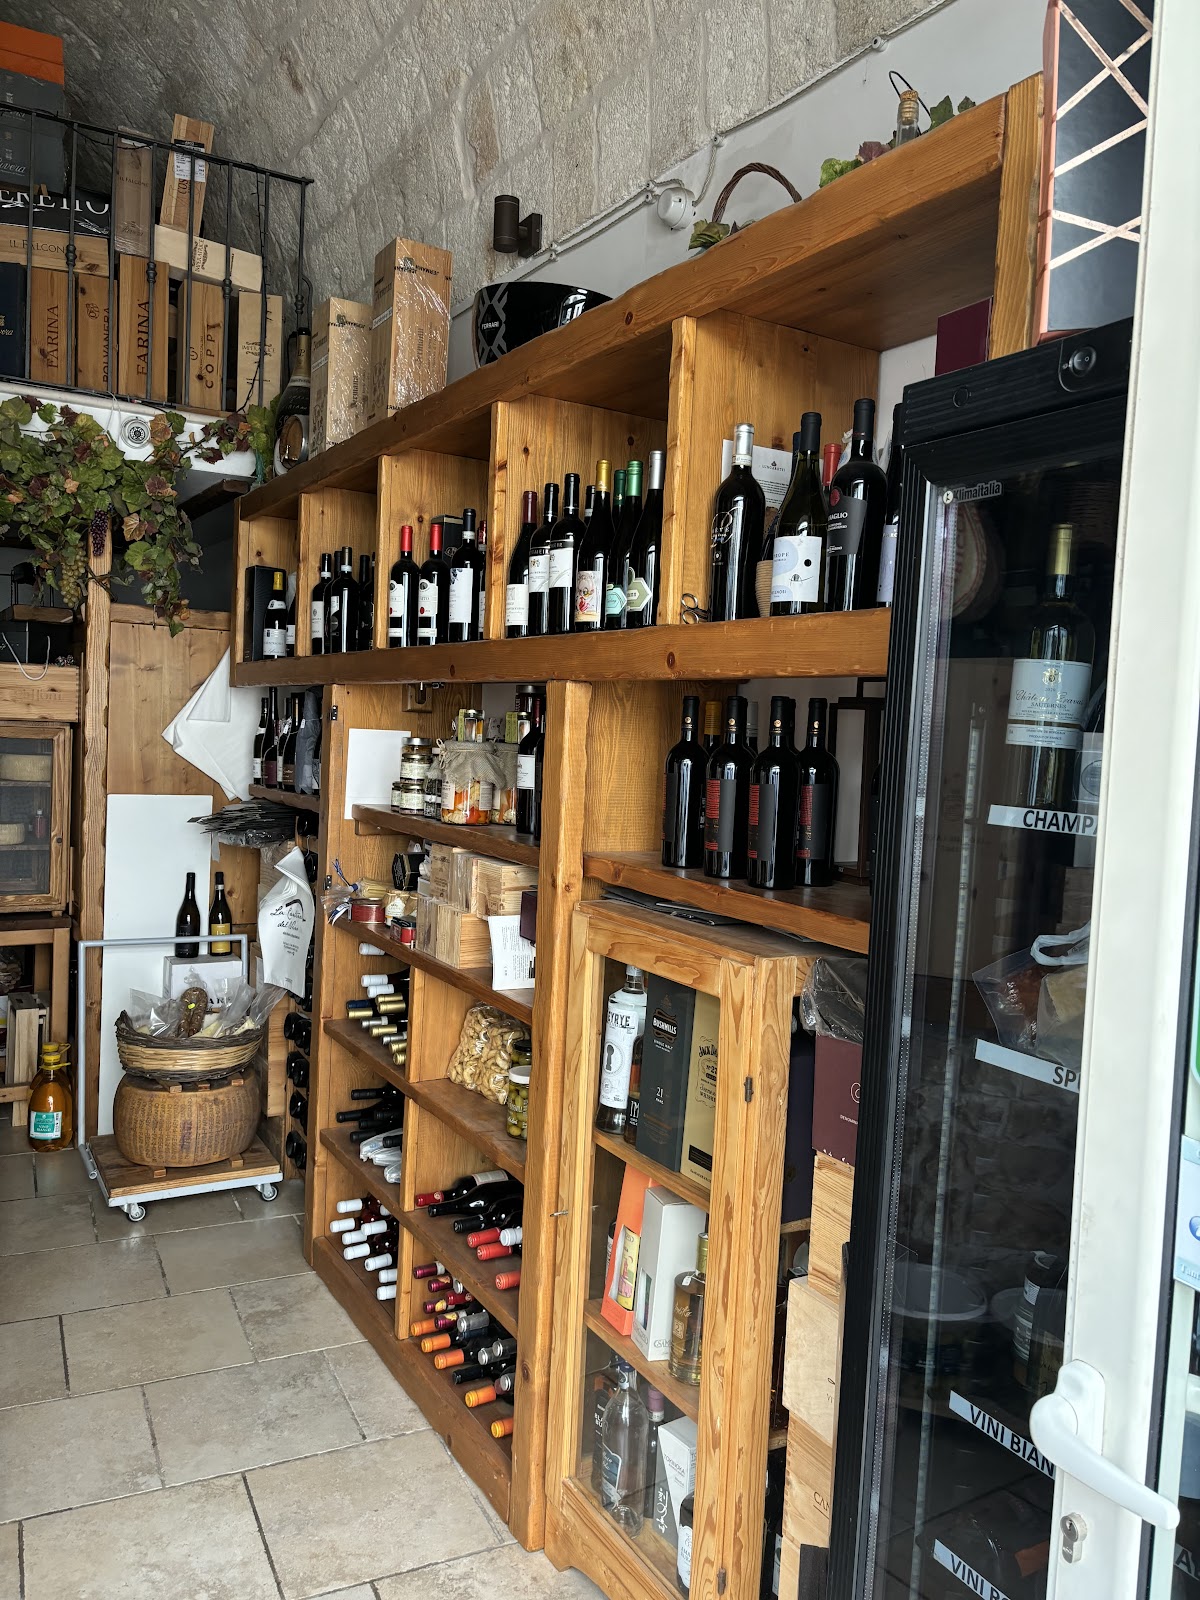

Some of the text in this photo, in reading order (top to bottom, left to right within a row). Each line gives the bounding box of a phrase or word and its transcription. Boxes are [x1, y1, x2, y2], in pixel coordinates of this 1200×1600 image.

[46, 304, 59, 370] FARINA
[136, 300, 149, 376] FARINA
[205, 322, 221, 389] COPPI
[953, 482, 1002, 502] Klimaitalia
[1030, 702, 1068, 710] SAUTERNES
[653, 1016, 678, 1035] BUSHMILLS
[656, 1086, 664, 1098] 21
[1052, 1066, 1080, 1091] SP
[970, 1404, 1005, 1445] VINI
[950, 1553, 986, 1596] VINI
